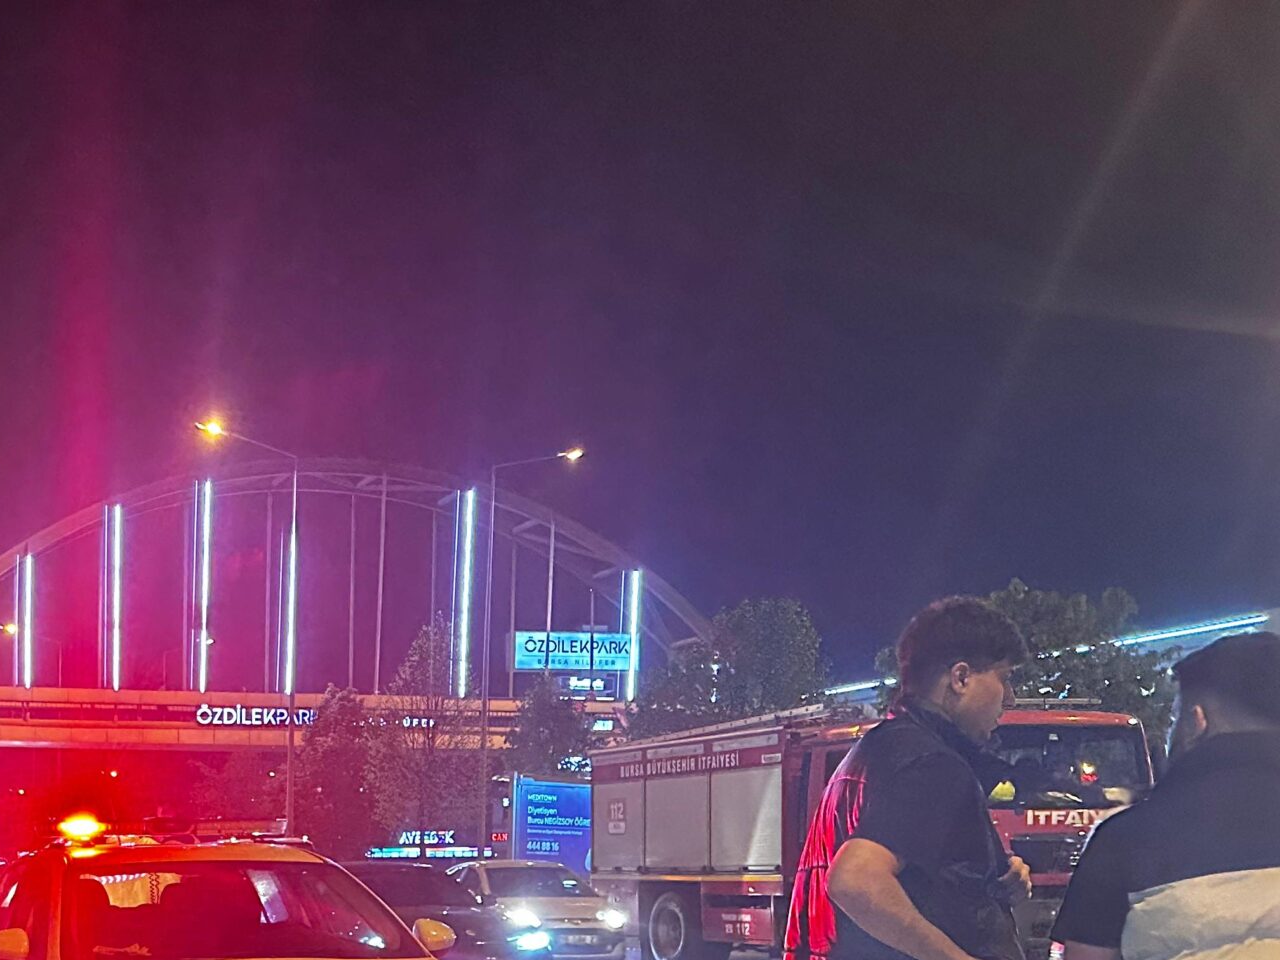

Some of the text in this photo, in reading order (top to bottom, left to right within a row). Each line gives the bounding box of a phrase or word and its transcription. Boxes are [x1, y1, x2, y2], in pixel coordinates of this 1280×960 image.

[524, 636, 629, 654] ÖZDİLEKPARK
[537, 658, 569, 666] BRSA
[620, 764, 644, 778] BURSA
[646, 757, 696, 776] BÜYÜKŞEHİR
[609, 802, 624, 820] 112
[526, 841, 540, 850] 444
